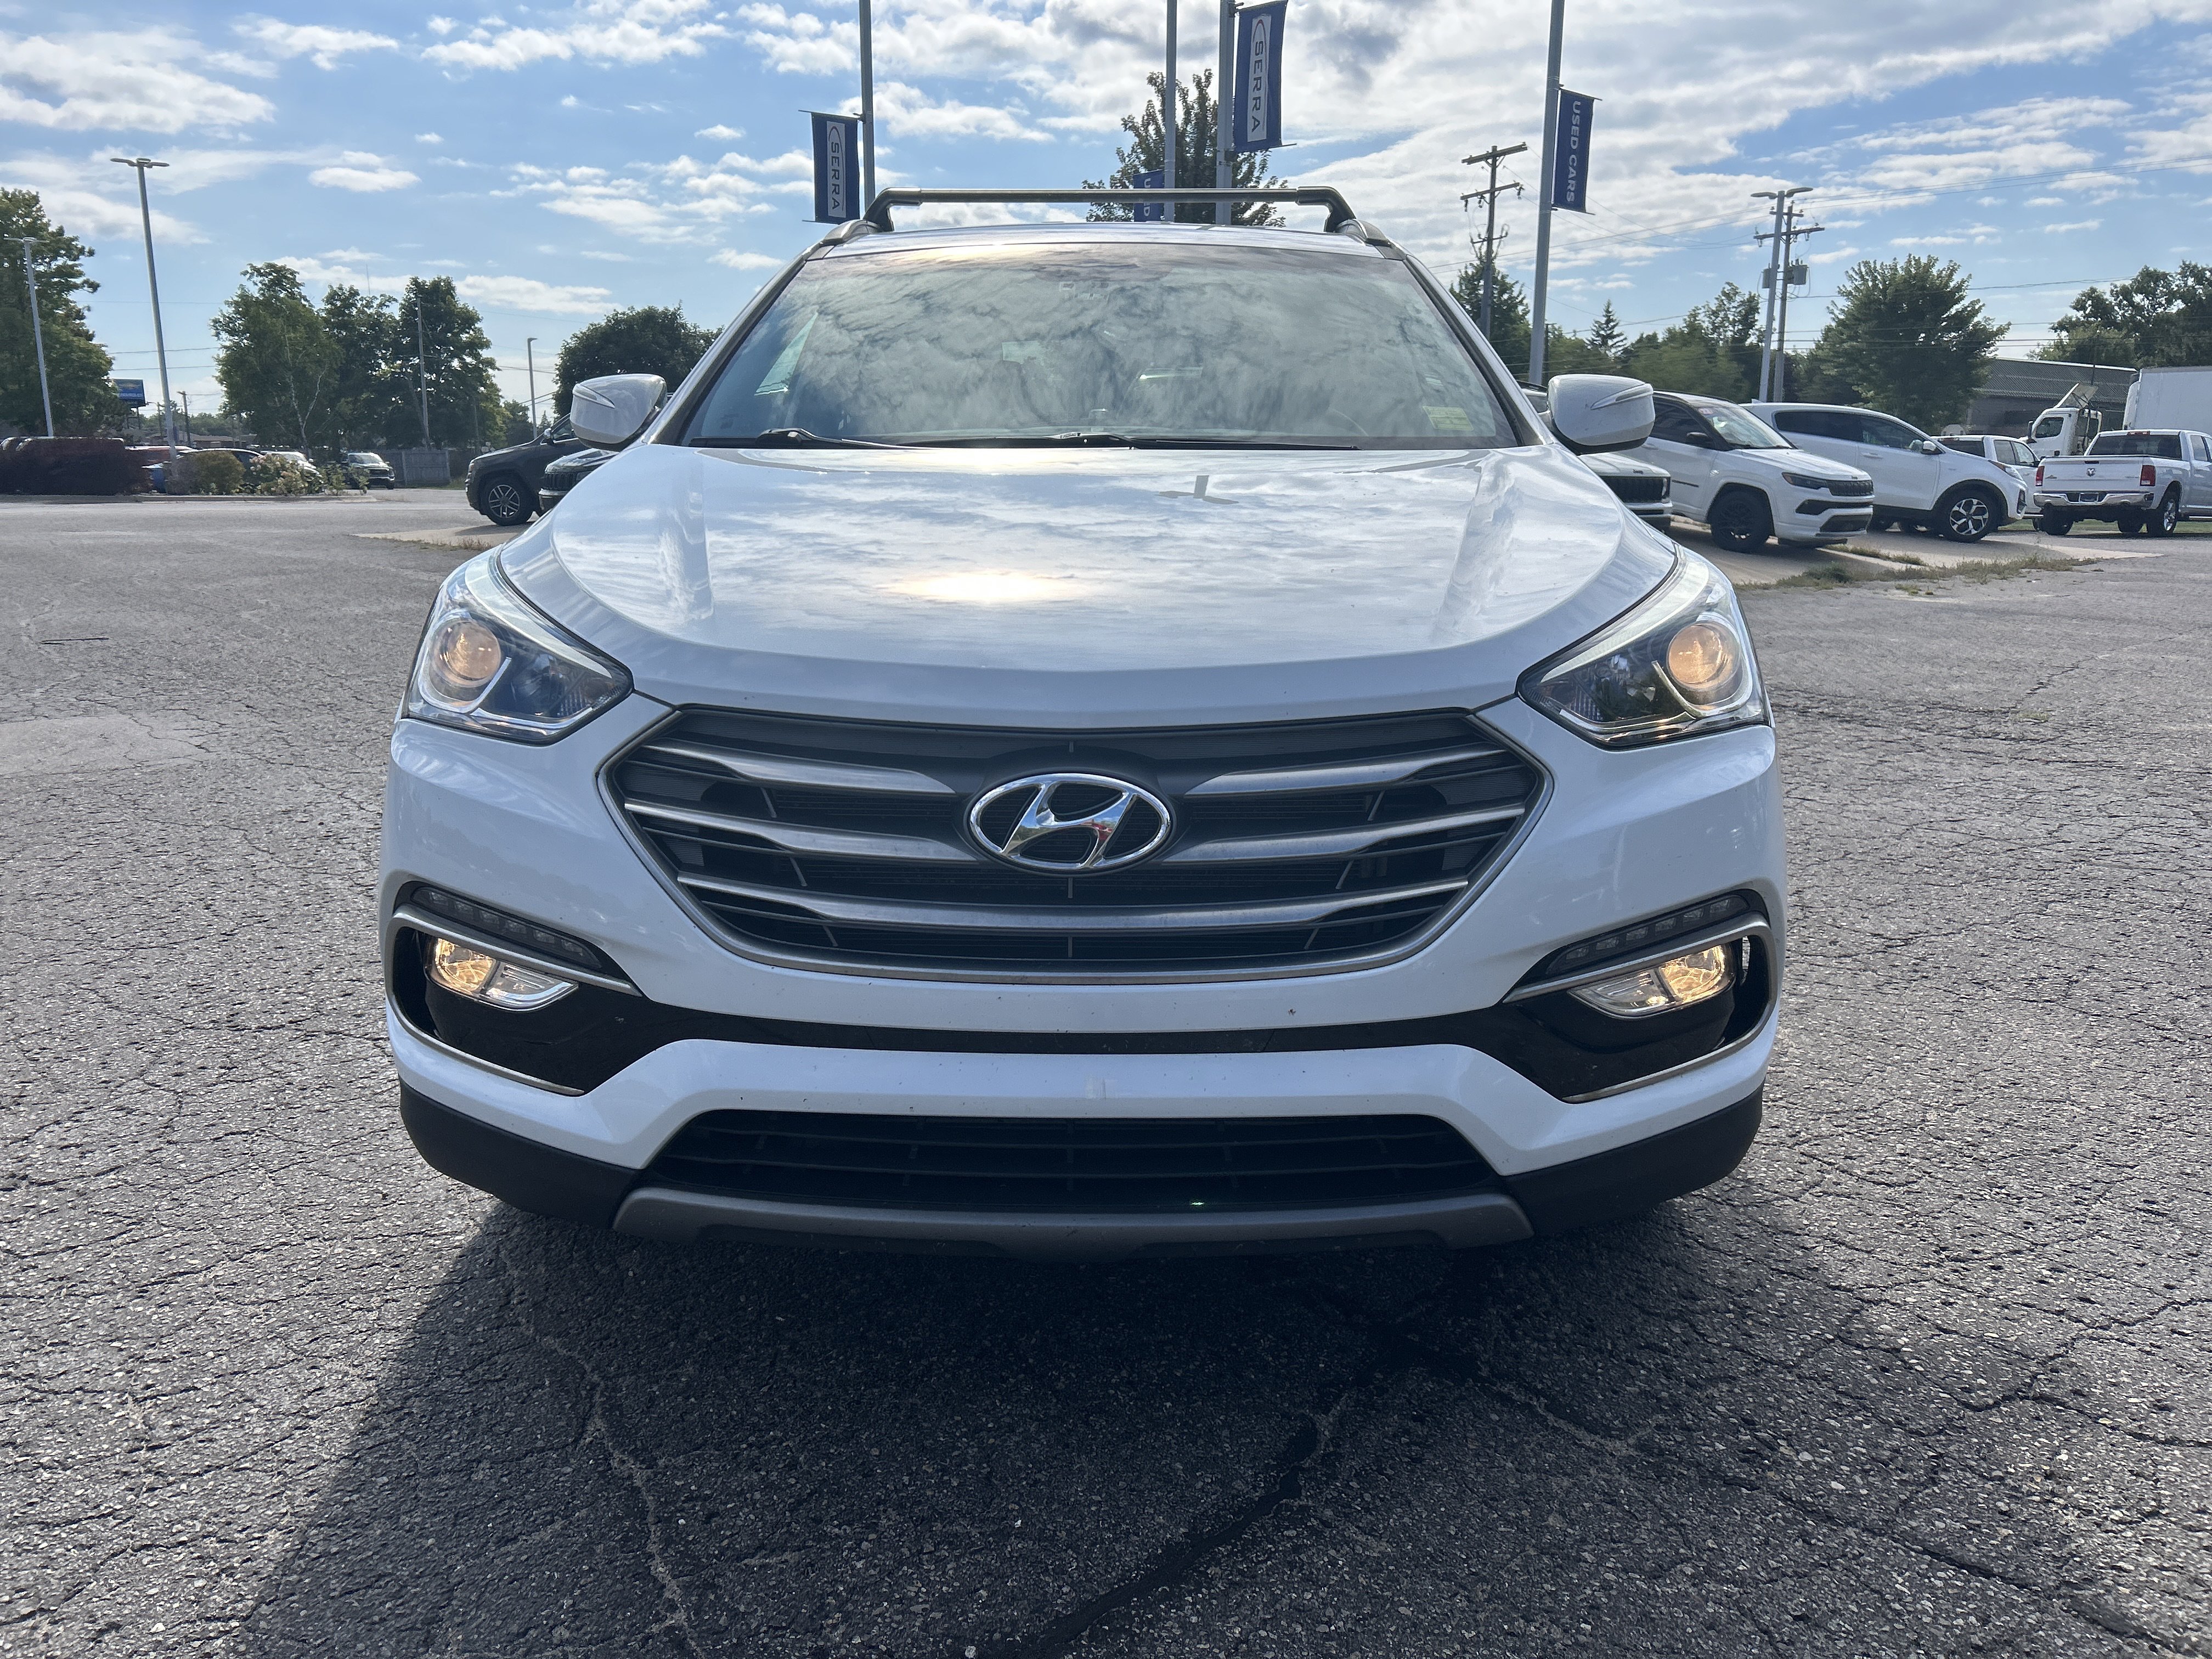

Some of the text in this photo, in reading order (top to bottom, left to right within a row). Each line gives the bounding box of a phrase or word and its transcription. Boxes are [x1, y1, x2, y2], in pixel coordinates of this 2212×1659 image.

[1251, 41, 1263, 133] SERRA
[831, 141, 840, 210] SERRA
[1566, 100, 1582, 202] USED CARS
[1143, 178, 1152, 217] UD
